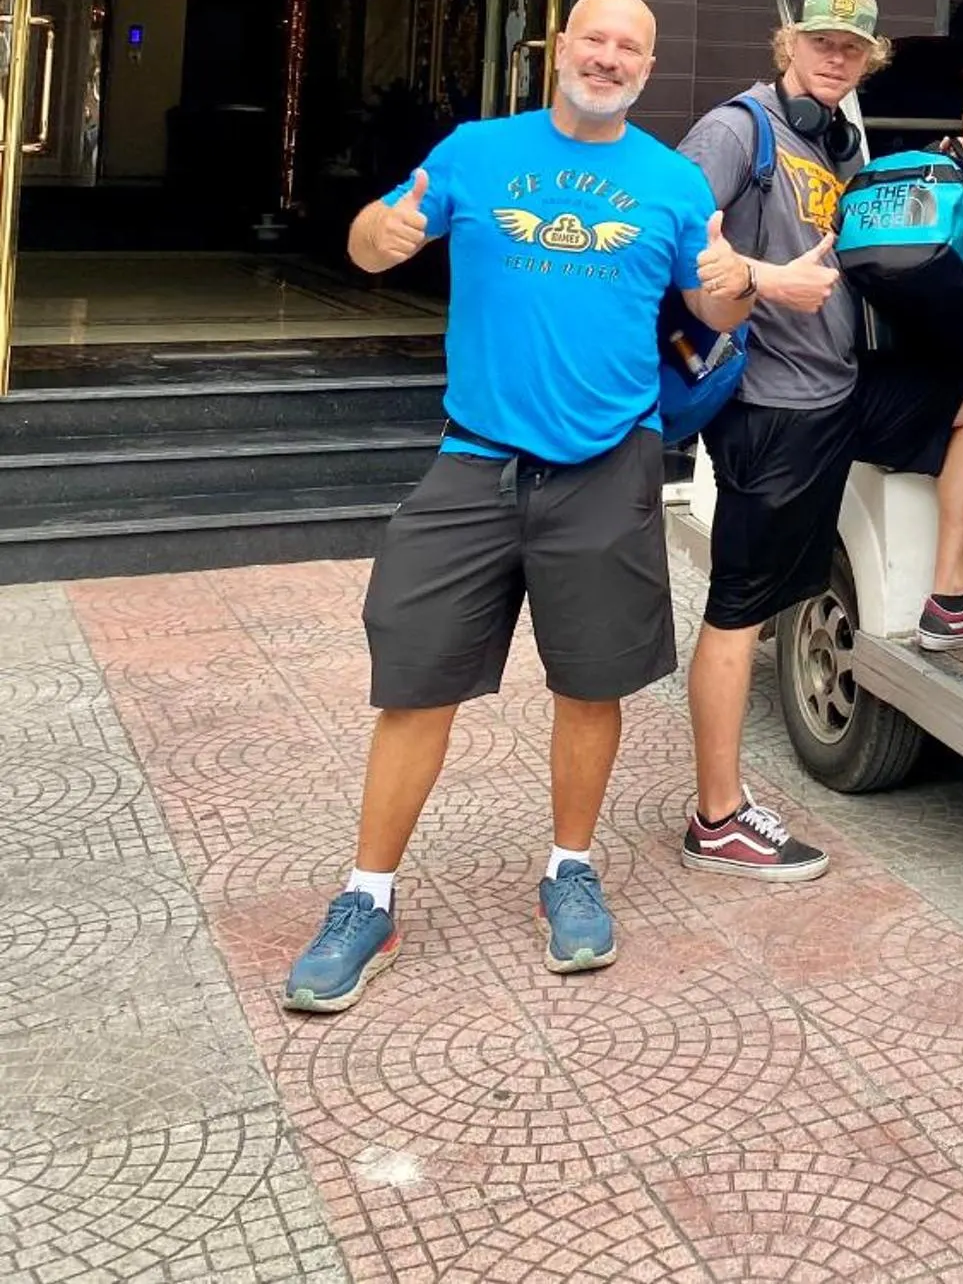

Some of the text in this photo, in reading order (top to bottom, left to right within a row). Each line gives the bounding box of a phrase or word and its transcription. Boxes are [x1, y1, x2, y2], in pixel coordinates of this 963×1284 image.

[508, 172, 541, 200] SE
[556, 169, 639, 212] CREW
[875, 183, 908, 199] THE
[846, 196, 905, 217] NORTH
[554, 217, 580, 233] SE
[860, 214, 905, 229] FACE
